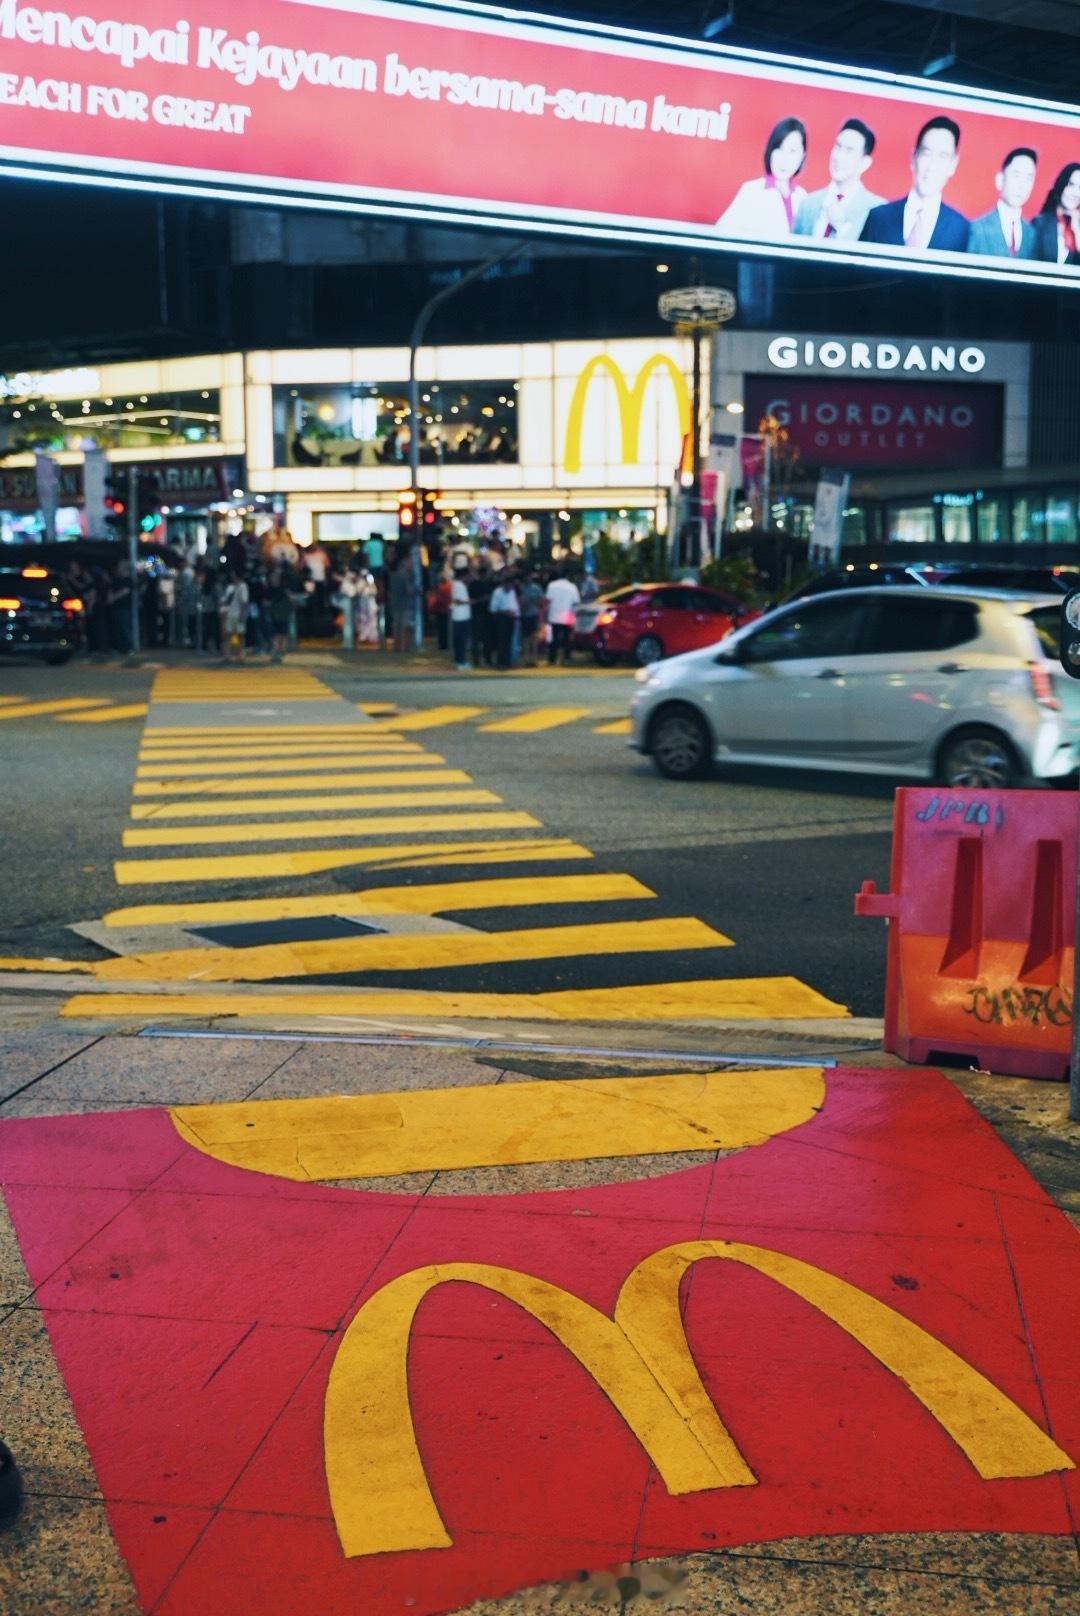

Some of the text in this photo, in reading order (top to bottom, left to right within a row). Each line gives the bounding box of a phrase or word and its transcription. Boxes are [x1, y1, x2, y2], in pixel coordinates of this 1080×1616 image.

[197, 27, 377, 91] Kejayaan
[384, 53, 647, 130] bersama-sama
[651, 95, 731, 141] kami
[0, 73, 251, 134] EACH FOR GREAT
[768, 336, 985, 373] GIORDANO
[766, 399, 974, 428] GIORDANO
[814, 430, 926, 449] OUTLET
